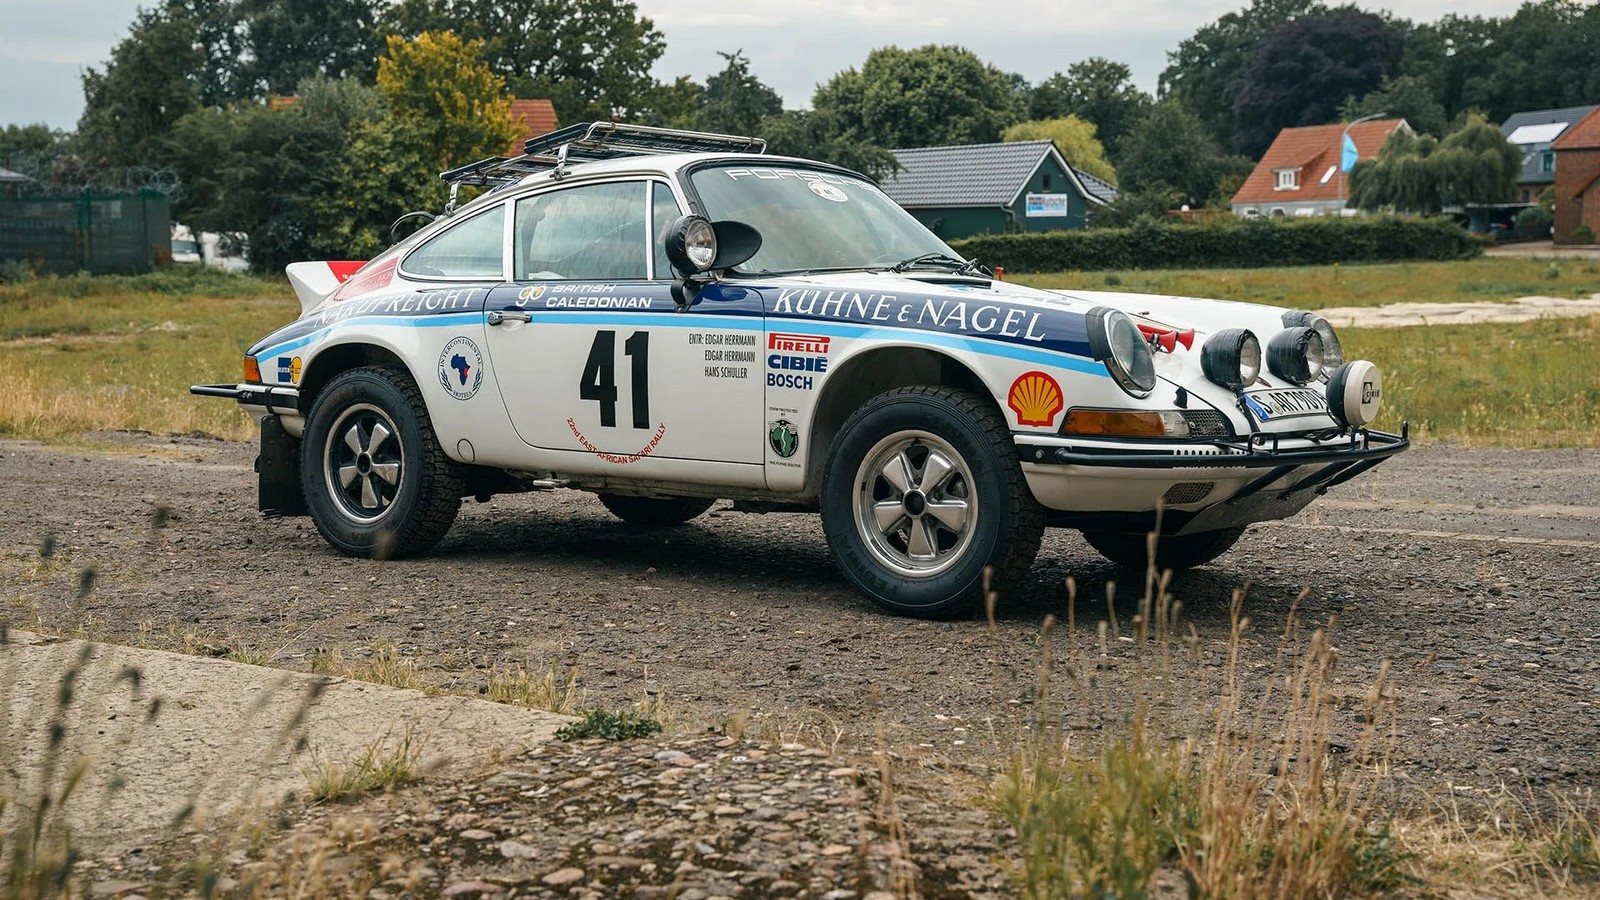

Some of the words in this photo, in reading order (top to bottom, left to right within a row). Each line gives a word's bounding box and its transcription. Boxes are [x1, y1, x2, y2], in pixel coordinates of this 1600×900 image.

[551, 284, 616, 293] BRITISH
[545, 297, 652, 308] CALEDONIAN
[773, 288, 898, 321] KÜHNE
[916, 299, 1047, 341] NAGEL
[688, 333, 704, 345] ENTR:
[705, 334, 723, 345] EDGAR
[724, 335, 756, 346] HERRMANN
[768, 333, 831, 353] PIRELLI
[439, 338, 482, 367] INTERCONTINENTAL
[705, 350, 723, 361] EDGAR
[724, 351, 756, 362] HERRMANN
[580, 330, 650, 429] 41
[705, 366, 720, 377] HANS
[767, 373, 813, 390] BOSCH
[1252, 395, 1274, 414] S
[567, 417, 581, 438] 22nd
[578, 435, 598, 453] EAST
[595, 451, 628, 465] AFRICAN
[628, 445, 653, 463] SAFARI
[649, 422, 667, 447] RALLY
